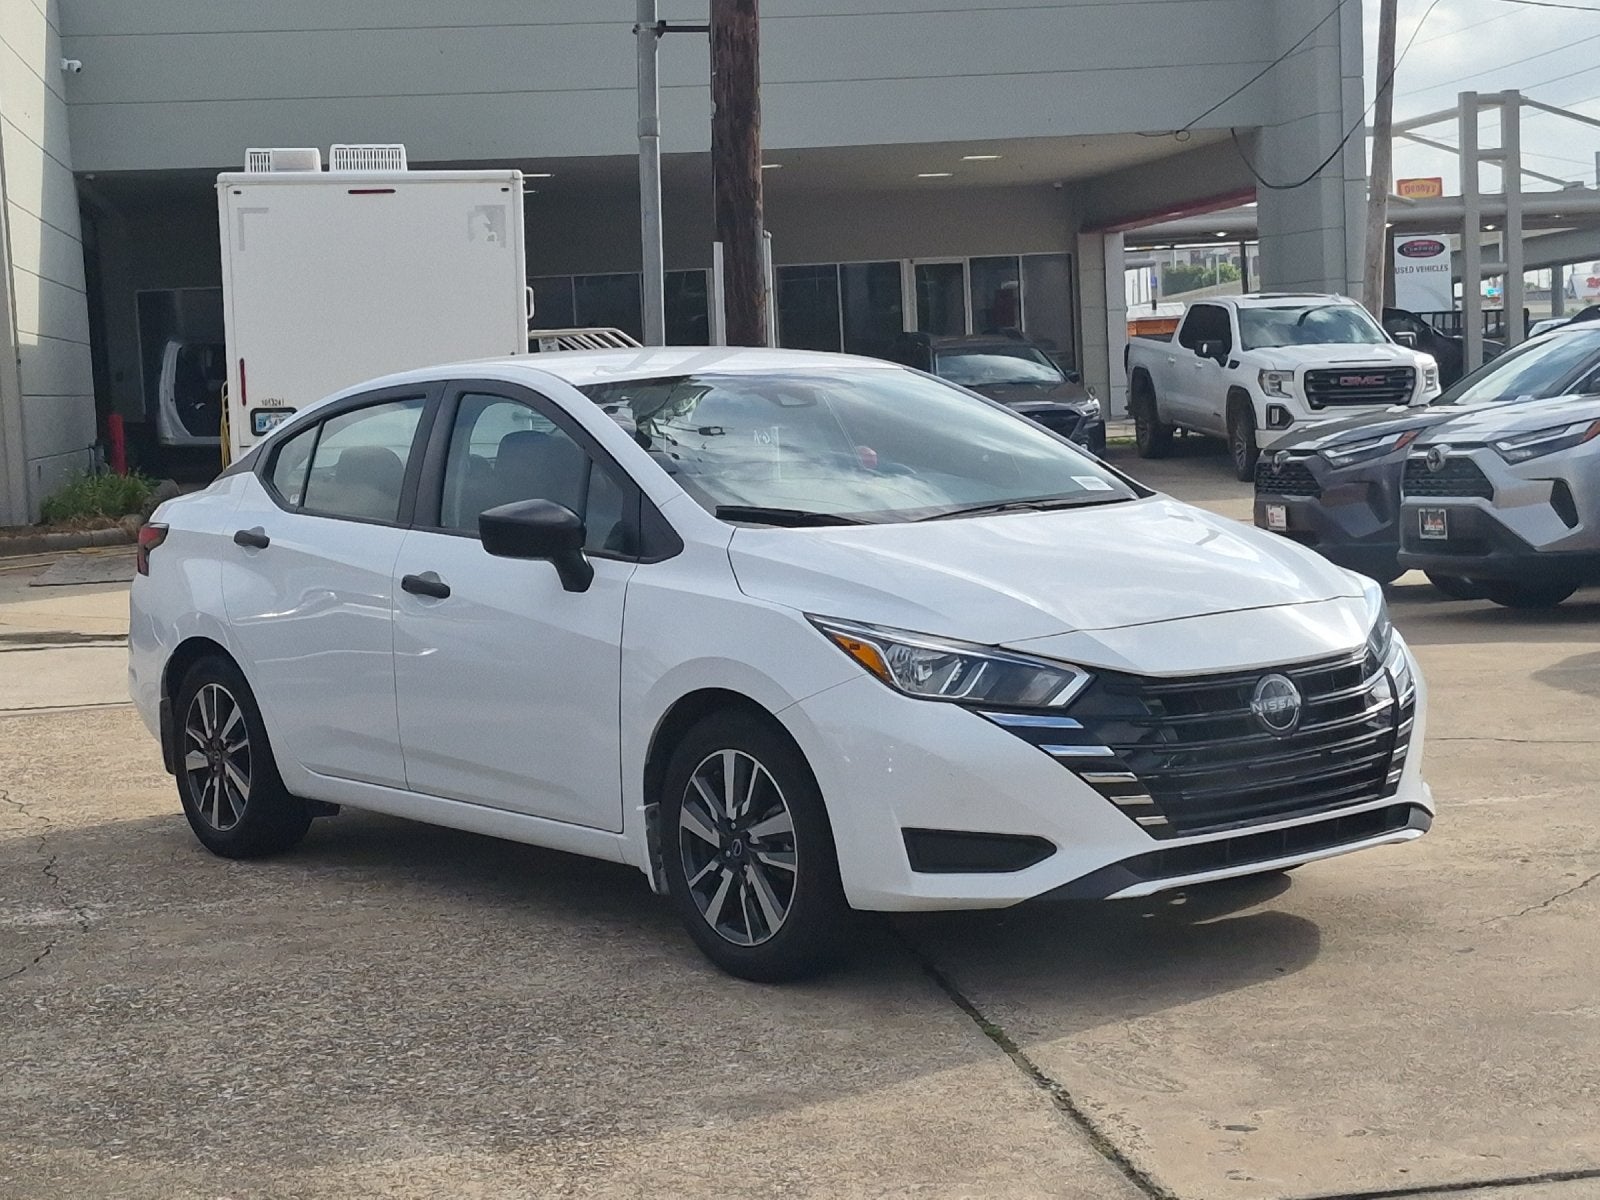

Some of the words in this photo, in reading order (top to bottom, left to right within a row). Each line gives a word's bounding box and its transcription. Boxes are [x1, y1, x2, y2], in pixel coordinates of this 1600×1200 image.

[1395, 265, 1414, 274] USED
[1416, 264, 1449, 273] VEHICLES
[1340, 375, 1385, 386] GMC
